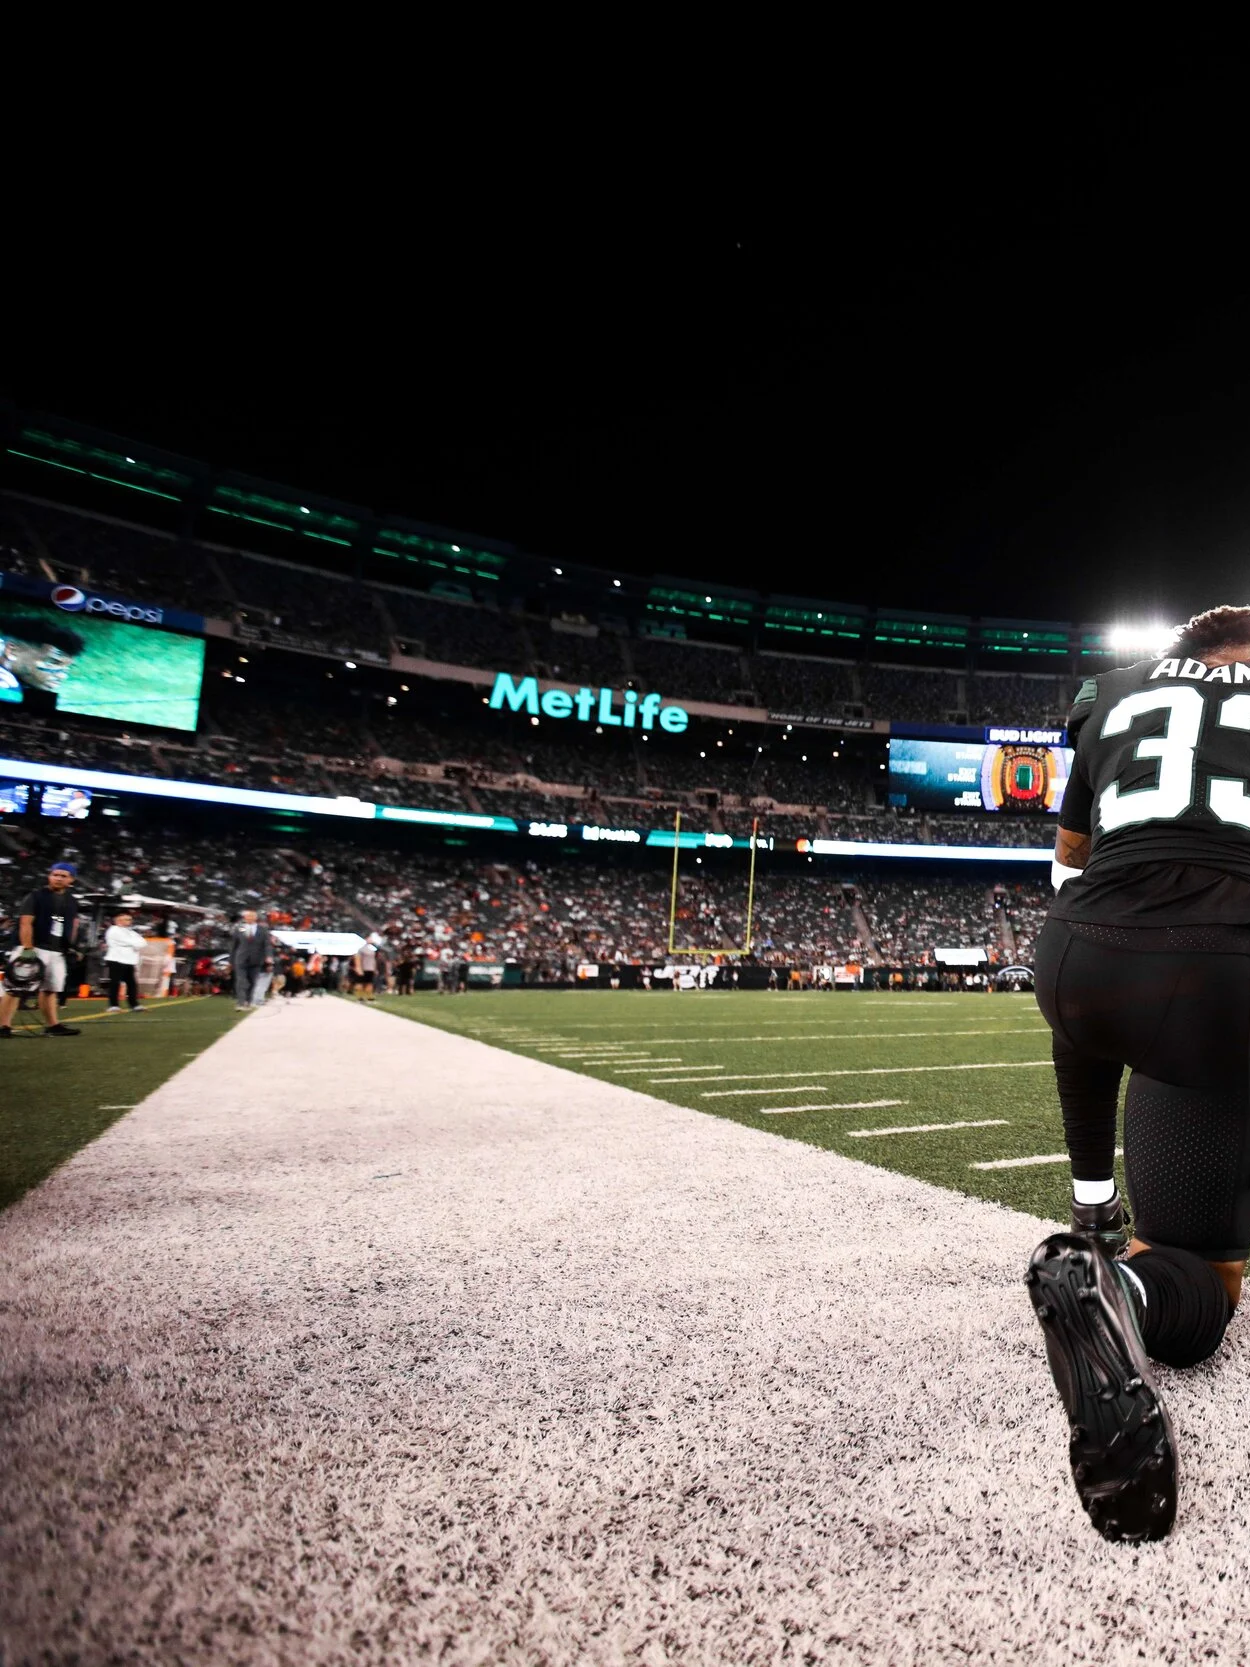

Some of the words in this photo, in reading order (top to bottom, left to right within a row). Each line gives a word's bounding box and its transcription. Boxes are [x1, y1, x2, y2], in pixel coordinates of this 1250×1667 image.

[86, 597, 163, 623] pepsi
[489, 672, 689, 733] MetLife
[805, 715, 821, 723] OF
[822, 717, 844, 726] THE
[844, 720, 872, 729] JETS
[989, 729, 1020, 742] BUD
[1020, 730, 1062, 744] LIGHT
